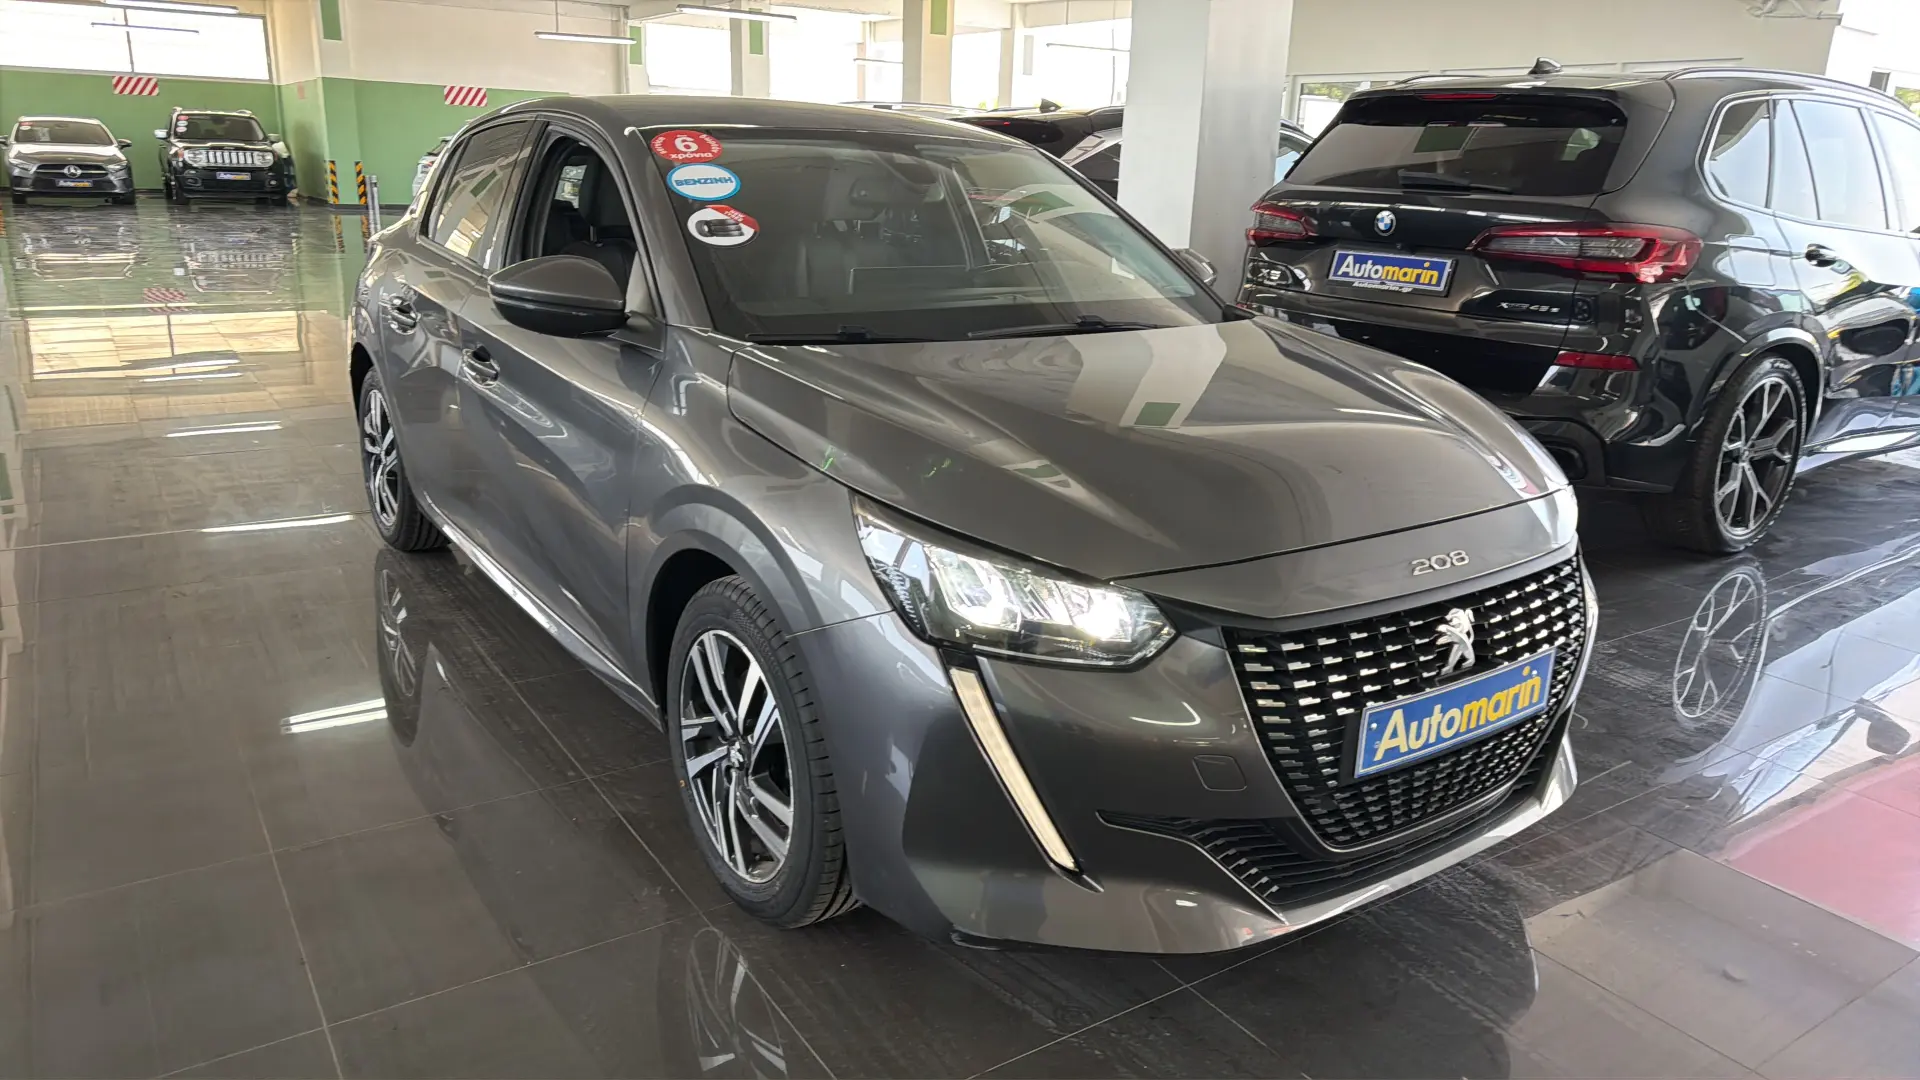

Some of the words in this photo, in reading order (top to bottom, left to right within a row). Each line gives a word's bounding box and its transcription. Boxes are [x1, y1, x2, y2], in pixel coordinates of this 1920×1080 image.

[674, 136, 698, 152] 6
[670, 152, 714, 160] χρόνια
[1258, 269, 1281, 280] X5
[1337, 254, 1440, 285] Automarin
[1352, 281, 1414, 293] Automarin.gr
[1411, 549, 1470, 576] 208
[1373, 665, 1542, 762] Automarin
